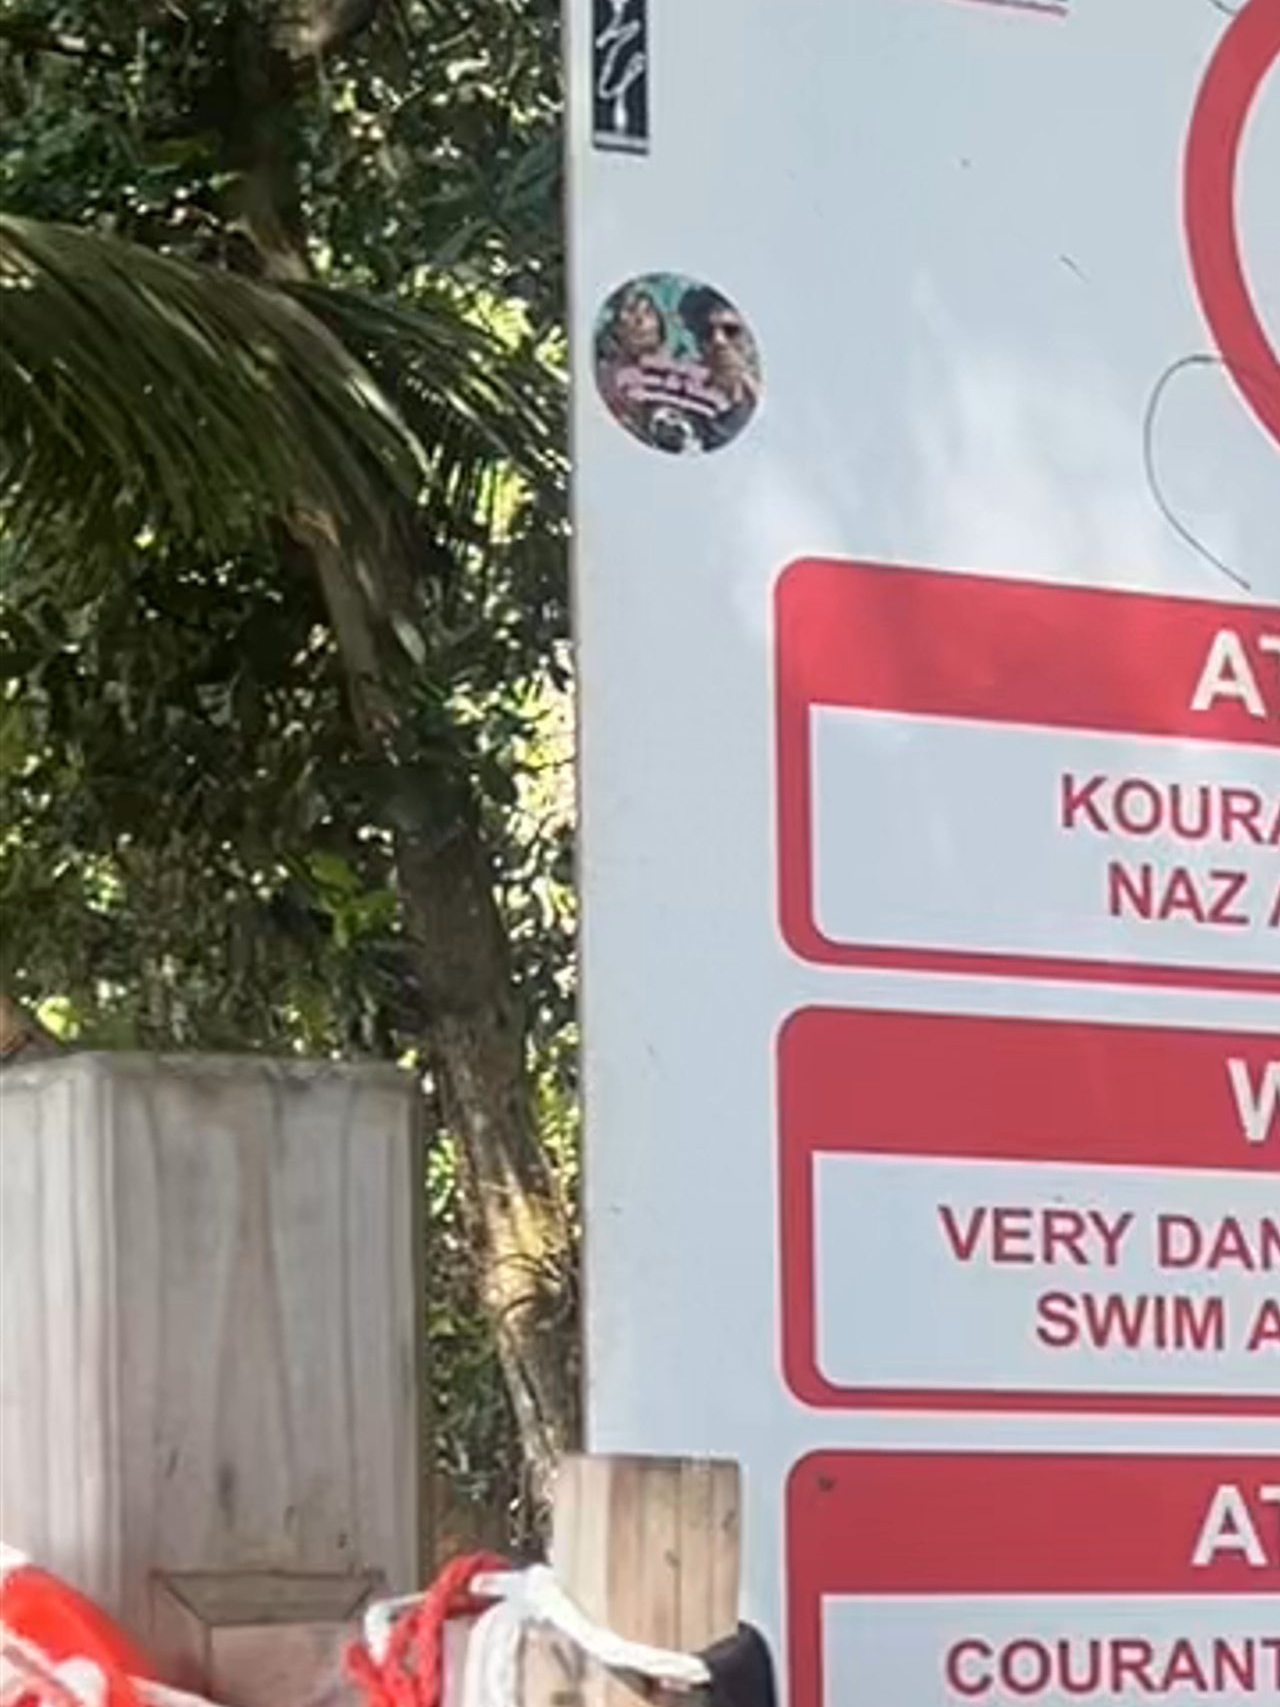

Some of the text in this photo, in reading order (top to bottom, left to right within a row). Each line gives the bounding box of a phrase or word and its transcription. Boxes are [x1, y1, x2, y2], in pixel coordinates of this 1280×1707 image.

[1109, 862, 1250, 926] NAZ
[938, 1205, 1134, 1267] VERY
[1036, 1291, 1224, 1351] SWIM
